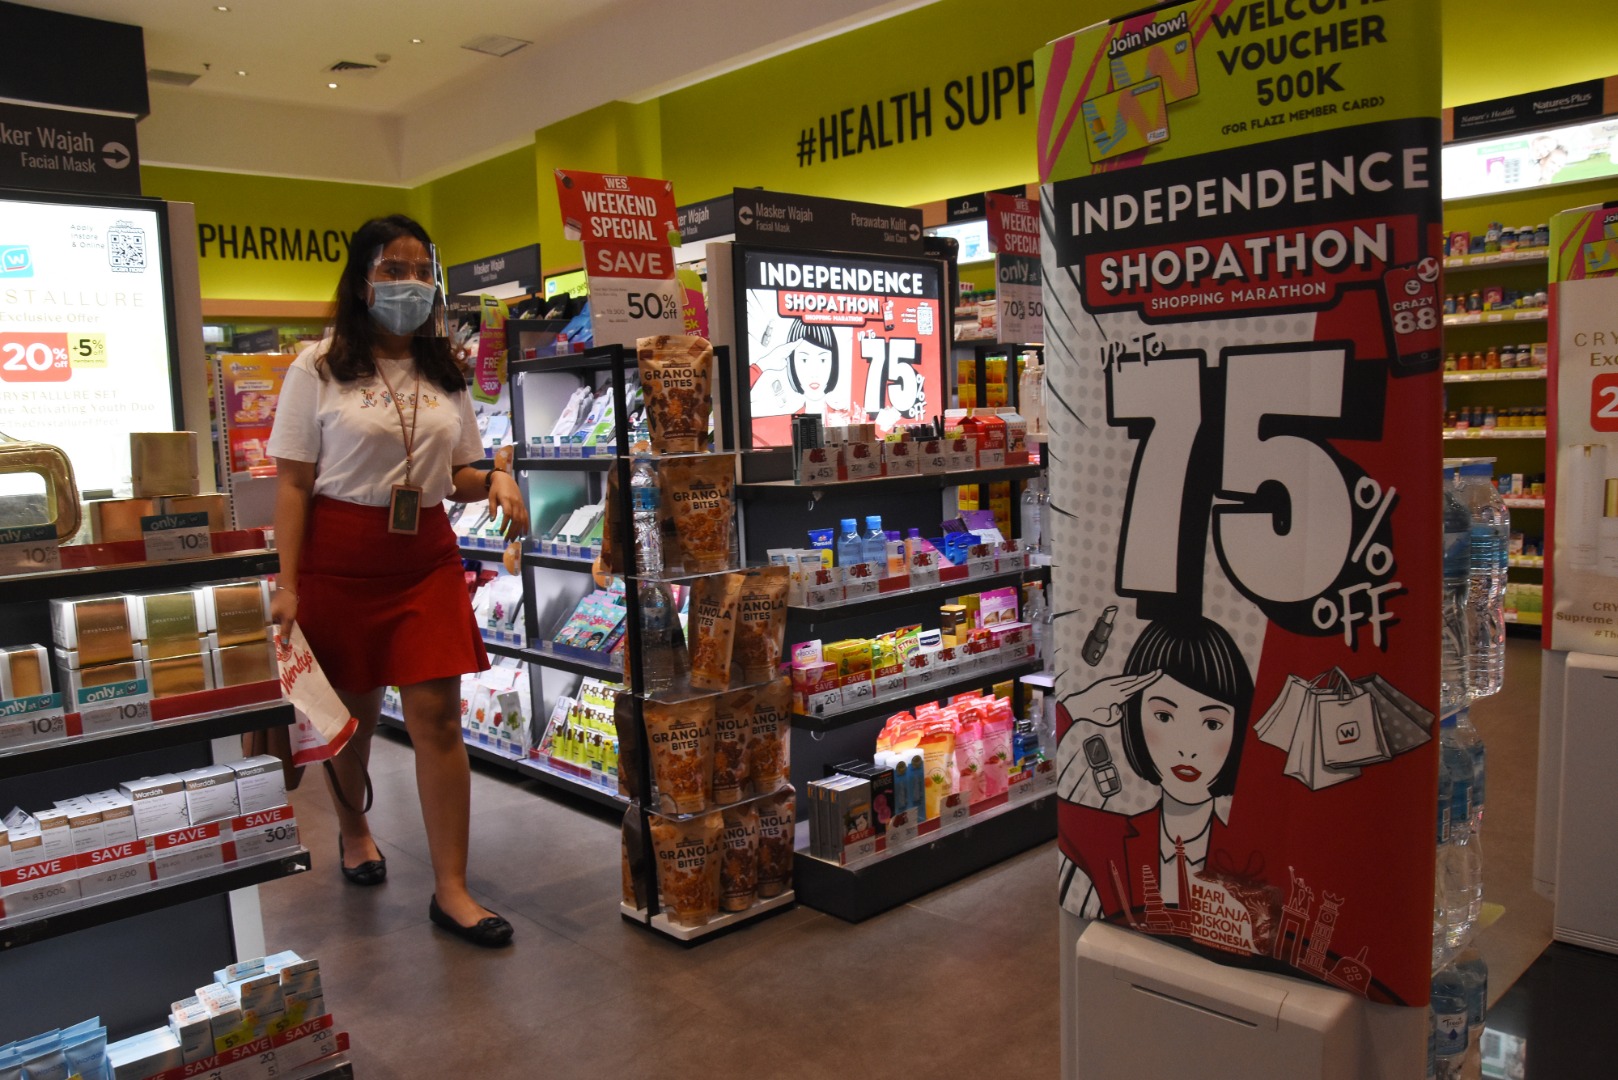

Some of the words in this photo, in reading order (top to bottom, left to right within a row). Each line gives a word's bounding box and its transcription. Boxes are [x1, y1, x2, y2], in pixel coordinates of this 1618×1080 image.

[1210, 0, 1385, 39] WELCO
[1109, 33, 1140, 55] Join
[1144, 12, 1187, 42] Now!
[1216, 15, 1388, 76] VOUCHER
[1256, 62, 1346, 106] 500K
[1251, 113, 1285, 132] FLAZZ
[1289, 104, 1338, 123] MEMBER
[1342, 96, 1385, 114] CARD)
[796, 87, 932, 168] #HEALTH
[0, 122, 32, 147] ker
[36, 127, 94, 154] Wajah
[21, 151, 59, 170] Facial
[62, 156, 97, 173] Mask
[605, 177, 629, 190] WES
[1072, 147, 1429, 237] INDEPENDENCE
[581, 191, 657, 218] WEEKEND
[756, 202, 787, 219] Masker
[788, 206, 813, 223] Wajah
[688, 208, 710, 226] Wajah
[851, 212, 890, 230] Perawatan
[890, 217, 908, 232] Kulit
[590, 216, 658, 241] SPECIAL
[199, 223, 355, 263] PHARMACY
[598, 249, 664, 275] SAVE
[1101, 223, 1388, 292] SHOPATHON
[760, 261, 923, 296] INDEPENDENCE
[1001, 259, 1029, 282] only
[784, 293, 880, 315] SHOPATHON
[1152, 289, 1225, 310] SHOPPING
[1231, 281, 1327, 303] MARATHON
[1393, 297, 1434, 311] CRAZY
[627, 292, 677, 320] 50%
[662, 308, 678, 320] off
[0, 311, 63, 324] Exclusive
[67, 312, 101, 325] Offer
[1394, 306, 1437, 334] 8.8
[1574, 331, 1618, 347] CRY
[2, 342, 68, 372] 20%
[645, 368, 708, 382] GRANOLA
[664, 379, 693, 388] BITES
[131, 402, 155, 412] Duo
[673, 489, 730, 502] GRANOLA
[692, 500, 720, 510] BITES
[150, 515, 178, 531] only
[743, 612, 770, 622] BITES
[1556, 611, 1614, 626] Supreme
[281, 650, 313, 695] Wendy's
[848, 672, 866, 684] SAVE
[881, 666, 898, 676] SAVE
[86, 686, 116, 703] only
[815, 681, 834, 692] SAVE
[116, 702, 149, 720] 10%
[29, 716, 64, 735] 10%
[716, 719, 749, 732] NOLA
[752, 723, 777, 736] BITES
[1340, 727, 1355, 739] W
[652, 727, 711, 744] GRANOLA
[671, 739, 699, 751] BITES
[240, 766, 265, 779] Wardah
[134, 787, 164, 800] Wardah
[189, 778, 216, 791] Wardah
[246, 809, 282, 827] SAVE
[168, 828, 207, 846] SAVE
[91, 843, 133, 863] SAVE
[659, 844, 720, 860] GRANOLA
[17, 860, 63, 881] SAVE
[677, 858, 705, 869] BITES
[1192, 884, 1225, 905] HARI
[1191, 897, 1250, 925] BELANJA
[1191, 911, 1242, 936] DISKON
[285, 1020, 321, 1041] SAVE
[232, 1039, 269, 1060] SAVE
